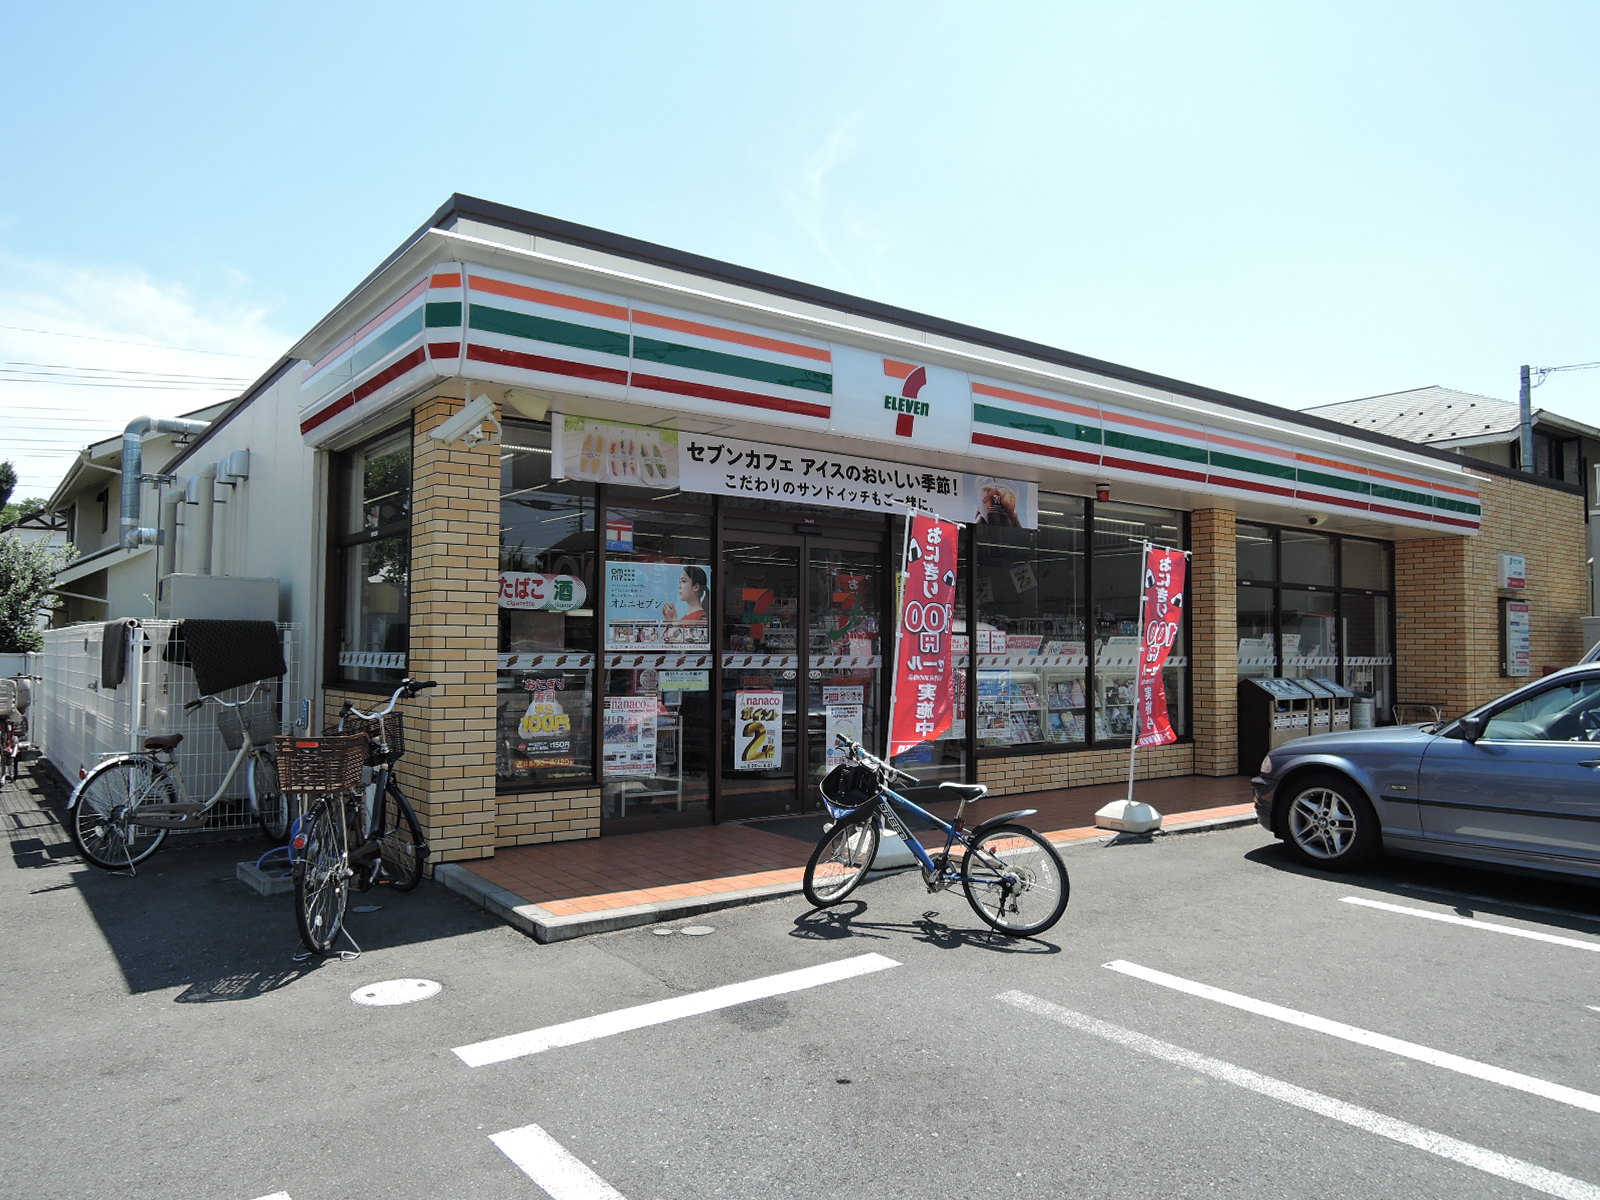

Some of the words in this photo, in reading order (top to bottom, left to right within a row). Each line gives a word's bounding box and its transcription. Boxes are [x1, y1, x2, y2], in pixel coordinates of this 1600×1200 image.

[883, 359, 927, 437] 7
[687, 442, 794, 471] セブンカフェ
[498, 576, 545, 599] たばこ
[553, 579, 574, 602] 酒
[610, 598, 664, 609] オムニセブン
[525, 678, 566, 691] おにぎり
[611, 700, 646, 710] nanaco
[746, 697, 780, 706] nanaco
[521, 714, 570, 733] 100円
[742, 722, 766, 761] 2
